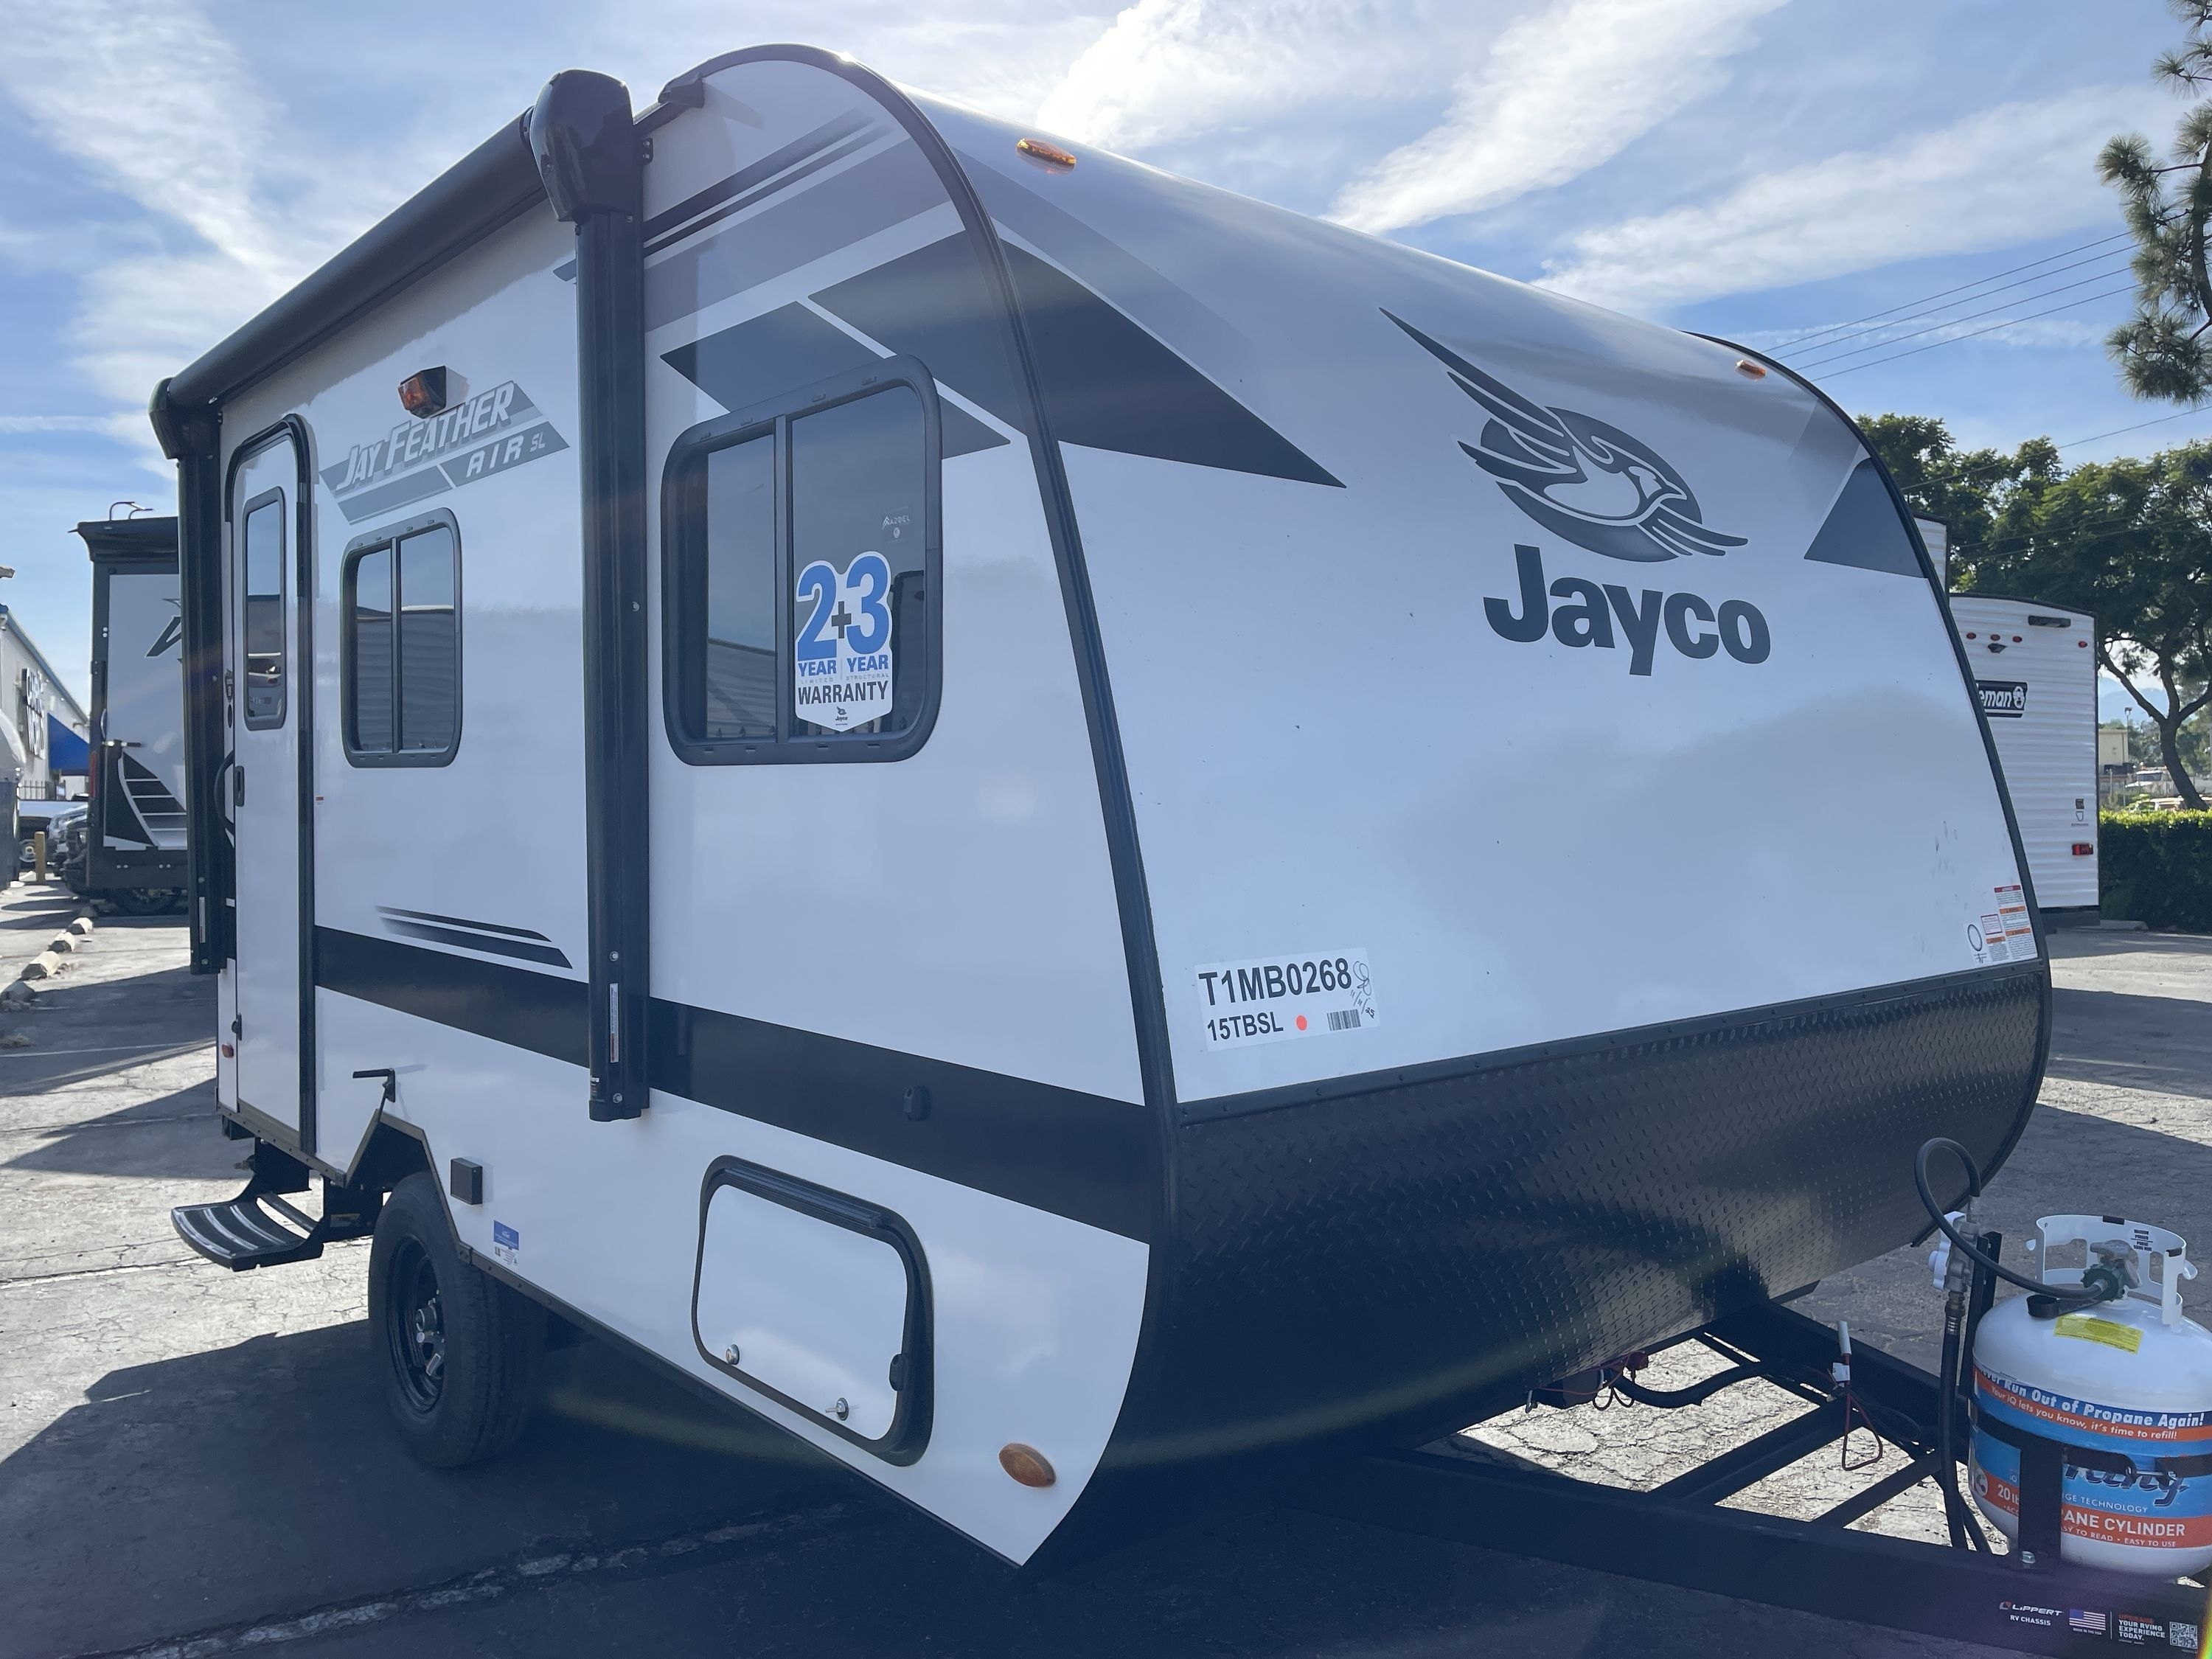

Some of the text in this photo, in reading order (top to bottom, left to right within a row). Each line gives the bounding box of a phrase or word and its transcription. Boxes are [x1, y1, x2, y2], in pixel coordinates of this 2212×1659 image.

[335, 380, 515, 491] JAY FEATHER
[465, 431, 546, 479] AIR SL
[1483, 543, 1770, 676] Jayco
[798, 654, 888, 677] YEAR YEAR
[798, 681, 888, 705] WARRANTY
[1198, 958, 1352, 1006] T1MB0268
[1207, 1011, 1284, 1041] 15TBSL
[1992, 1385, 2006, 1398] Your
[2019, 1399, 2034, 1412] lets
[2036, 1408, 2053, 1419] you
[2056, 1413, 2087, 1430] know,
[2110, 1426, 2134, 1436] time
[2138, 1430, 2148, 1438] to
[2151, 1431, 2177, 1439] refill!
[2004, 1379, 2027, 1397] Run
[2031, 1389, 2057, 1407] Out
[2062, 1400, 2079, 1413] of
[2083, 1403, 2153, 1426] Propane
[2157, 1412, 2205, 1429] Again!
[1997, 1484, 2010, 1501] 20
[2062, 1493, 2148, 1513] GE TECHNOLOGY
[2062, 1509, 2185, 1537] ANE CYLINDER
[2076, 1528, 2087, 1537] TO
[2090, 1532, 2113, 1542] READ
[2124, 1537, 2145, 1546] EASY
[2020, 1616, 2051, 1626] CHASSIS
[2118, 1619, 2138, 1628] YOUR
[2118, 1625, 2166, 1638] EXPERIENCE
[2118, 1631, 2144, 1641] TODAY.
